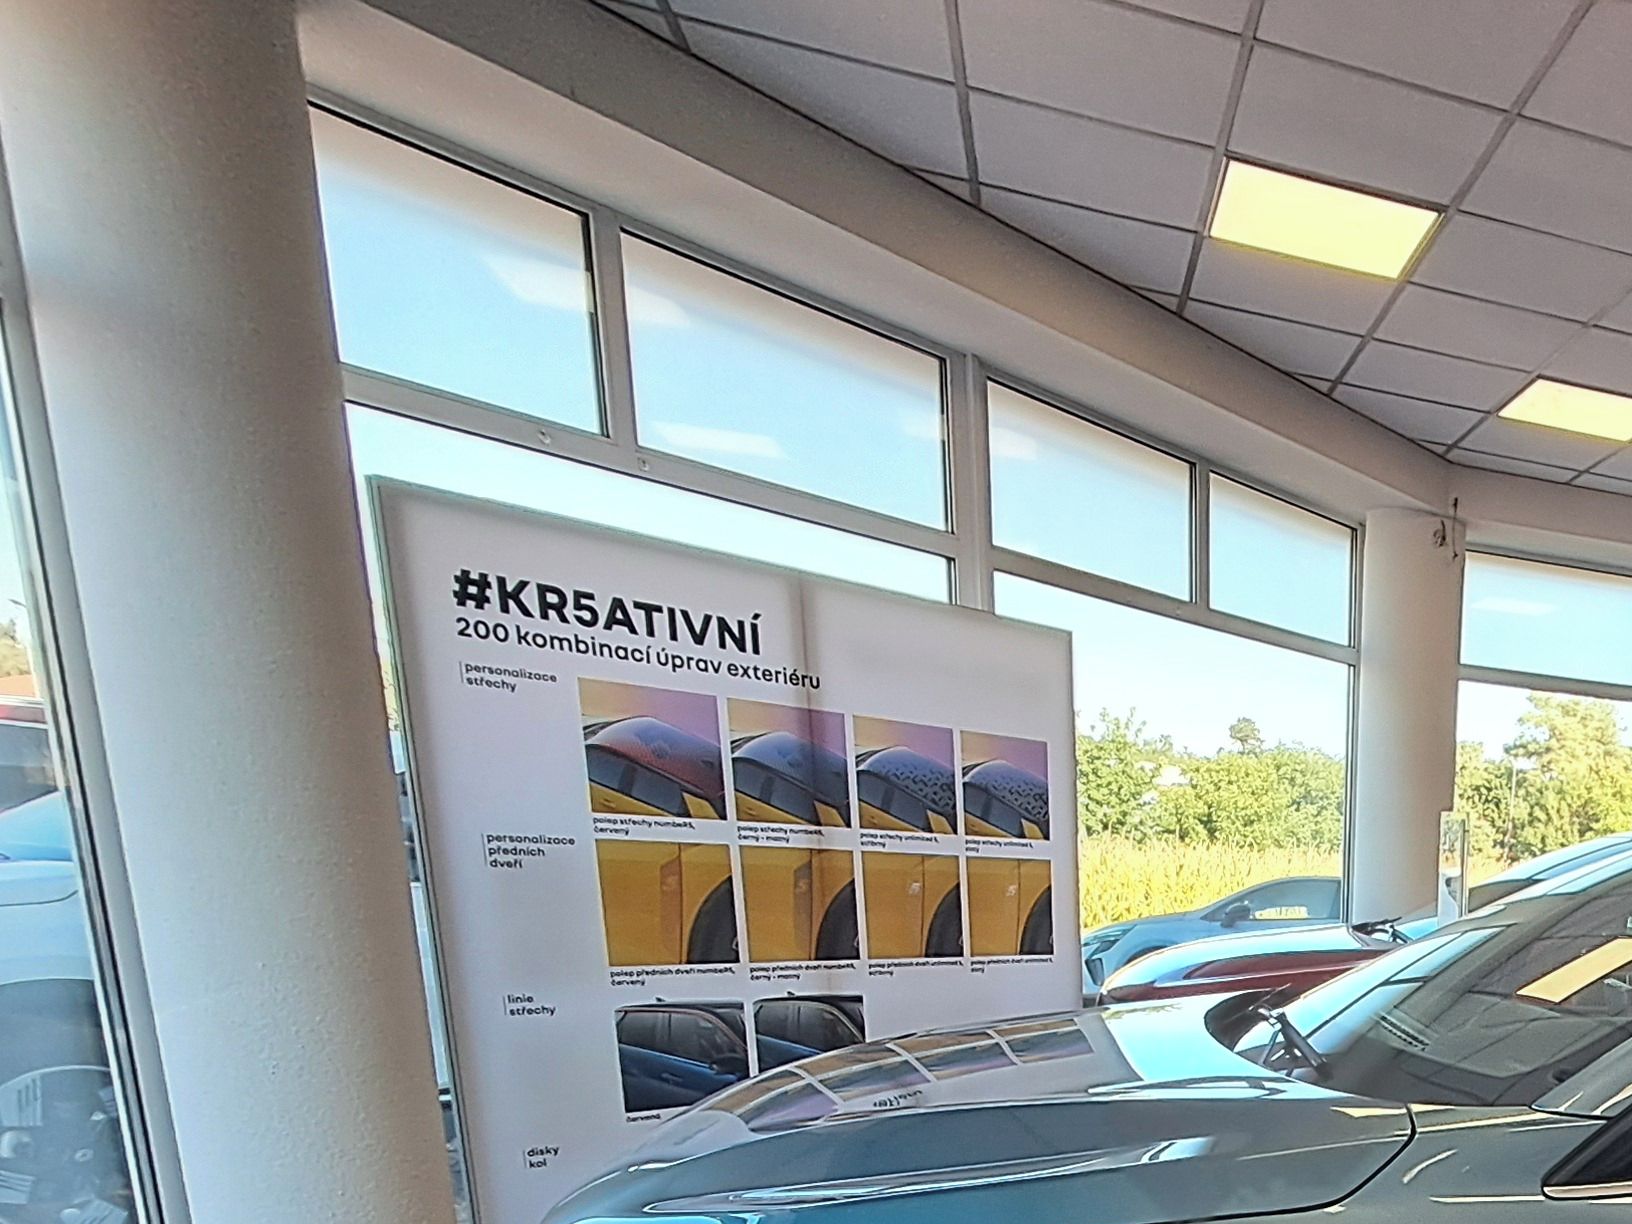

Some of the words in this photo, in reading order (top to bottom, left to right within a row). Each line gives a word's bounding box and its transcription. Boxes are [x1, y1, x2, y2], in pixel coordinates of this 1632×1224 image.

[452, 569, 762, 656] #KR5ATIVNÍ
[457, 617, 510, 644] 200
[516, 624, 652, 665] kombinací
[657, 646, 723, 675] úprav
[727, 663, 821, 690] exteriéru
[464, 663, 557, 683] personalizace
[466, 676, 517, 693] střechy
[486, 834, 576, 846] personalizace
[488, 845, 546, 857] předních
[489, 858, 523, 869] dveří
[507, 993, 534, 1004] linie
[509, 1004, 556, 1017] střechy
[526, 1146, 560, 1158] disky
[528, 1158, 548, 1169] kol
